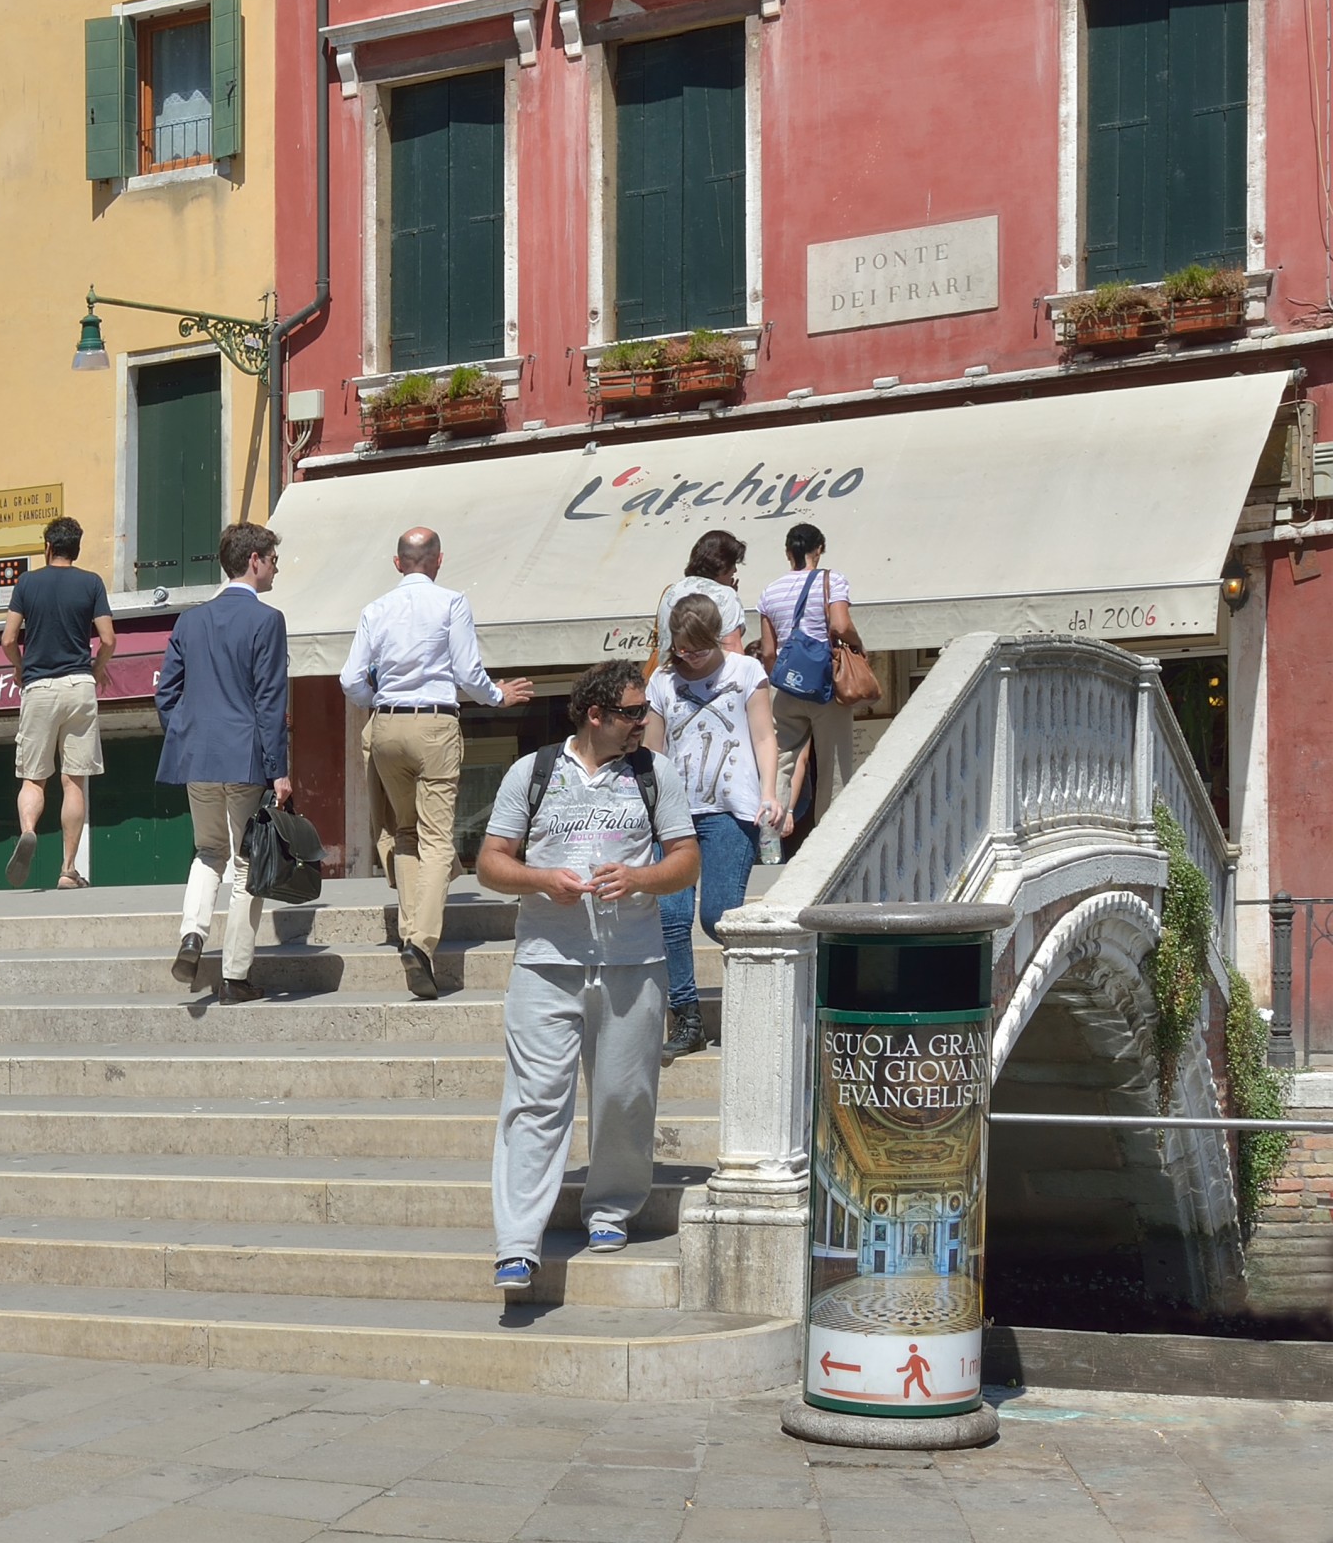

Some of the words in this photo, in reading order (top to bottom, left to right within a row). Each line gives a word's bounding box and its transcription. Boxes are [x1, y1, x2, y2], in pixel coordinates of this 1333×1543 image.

[854, 242, 950, 273] PONTE
[831, 288, 876, 312] DEI
[888, 274, 972, 303] FRARI
[45, 492, 52, 504] DI
[18, 507, 59, 522] EVANGELISTA
[1068, 609, 1093, 632] dal
[1102, 605, 1156, 630] 2006
[547, 808, 595, 843] Royal
[593, 808, 646, 830] Falcon
[824, 1031, 921, 1058] SCUOLA
[831, 1057, 878, 1082] SAN
[960, 1357, 965, 1378] 1
